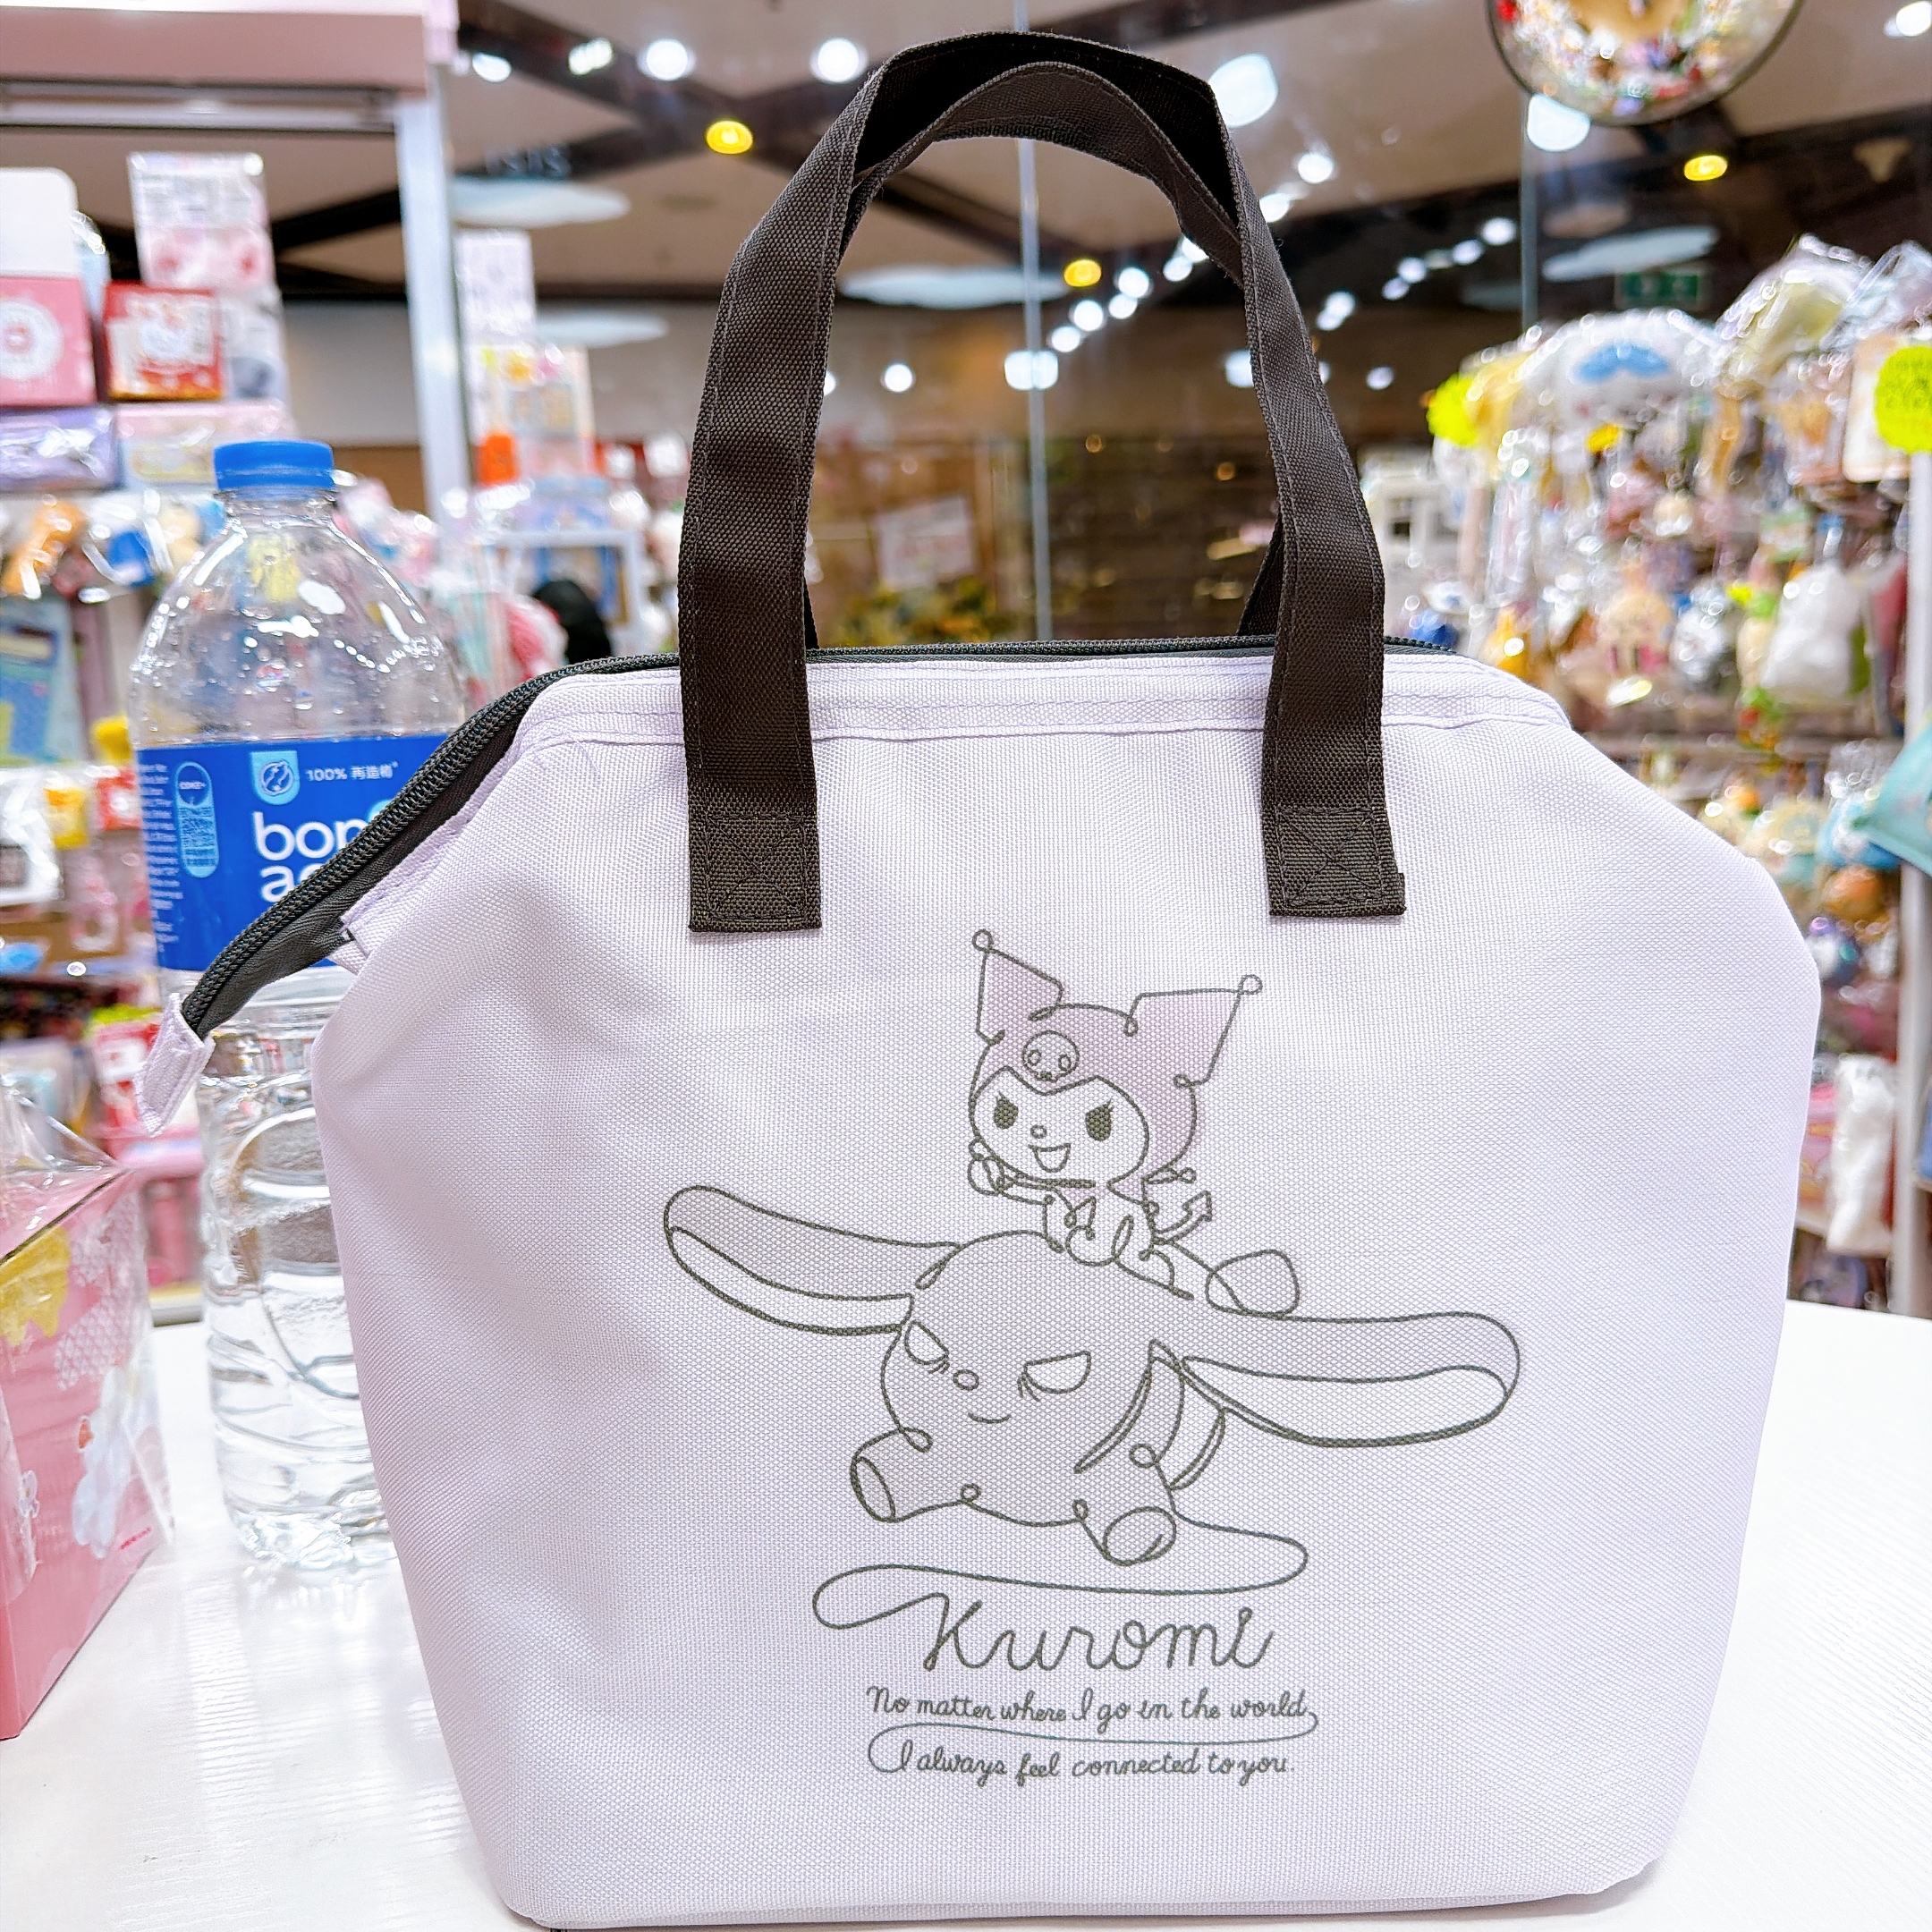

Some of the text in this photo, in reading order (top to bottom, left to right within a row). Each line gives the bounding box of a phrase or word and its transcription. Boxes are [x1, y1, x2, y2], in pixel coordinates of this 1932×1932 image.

[306, 767, 348, 781] 100%
[923, 1592, 1275, 1672] Kuromi
[866, 1685, 910, 1714] No
[917, 1695, 996, 1721] matter
[1001, 1689, 1067, 1722] where
[1072, 1687, 1094, 1722] I
[1097, 1701, 1131, 1734] go
[1137, 1699, 1174, 1719] in
[1181, 1686, 1222, 1720] the
[917, 1745, 1007, 1787] always
[1014, 1751, 1061, 1787] feel
[1072, 1747, 1201, 1777] connected
[1208, 1750, 1233, 1775] to
[1237, 1756, 1295, 1787] you.
